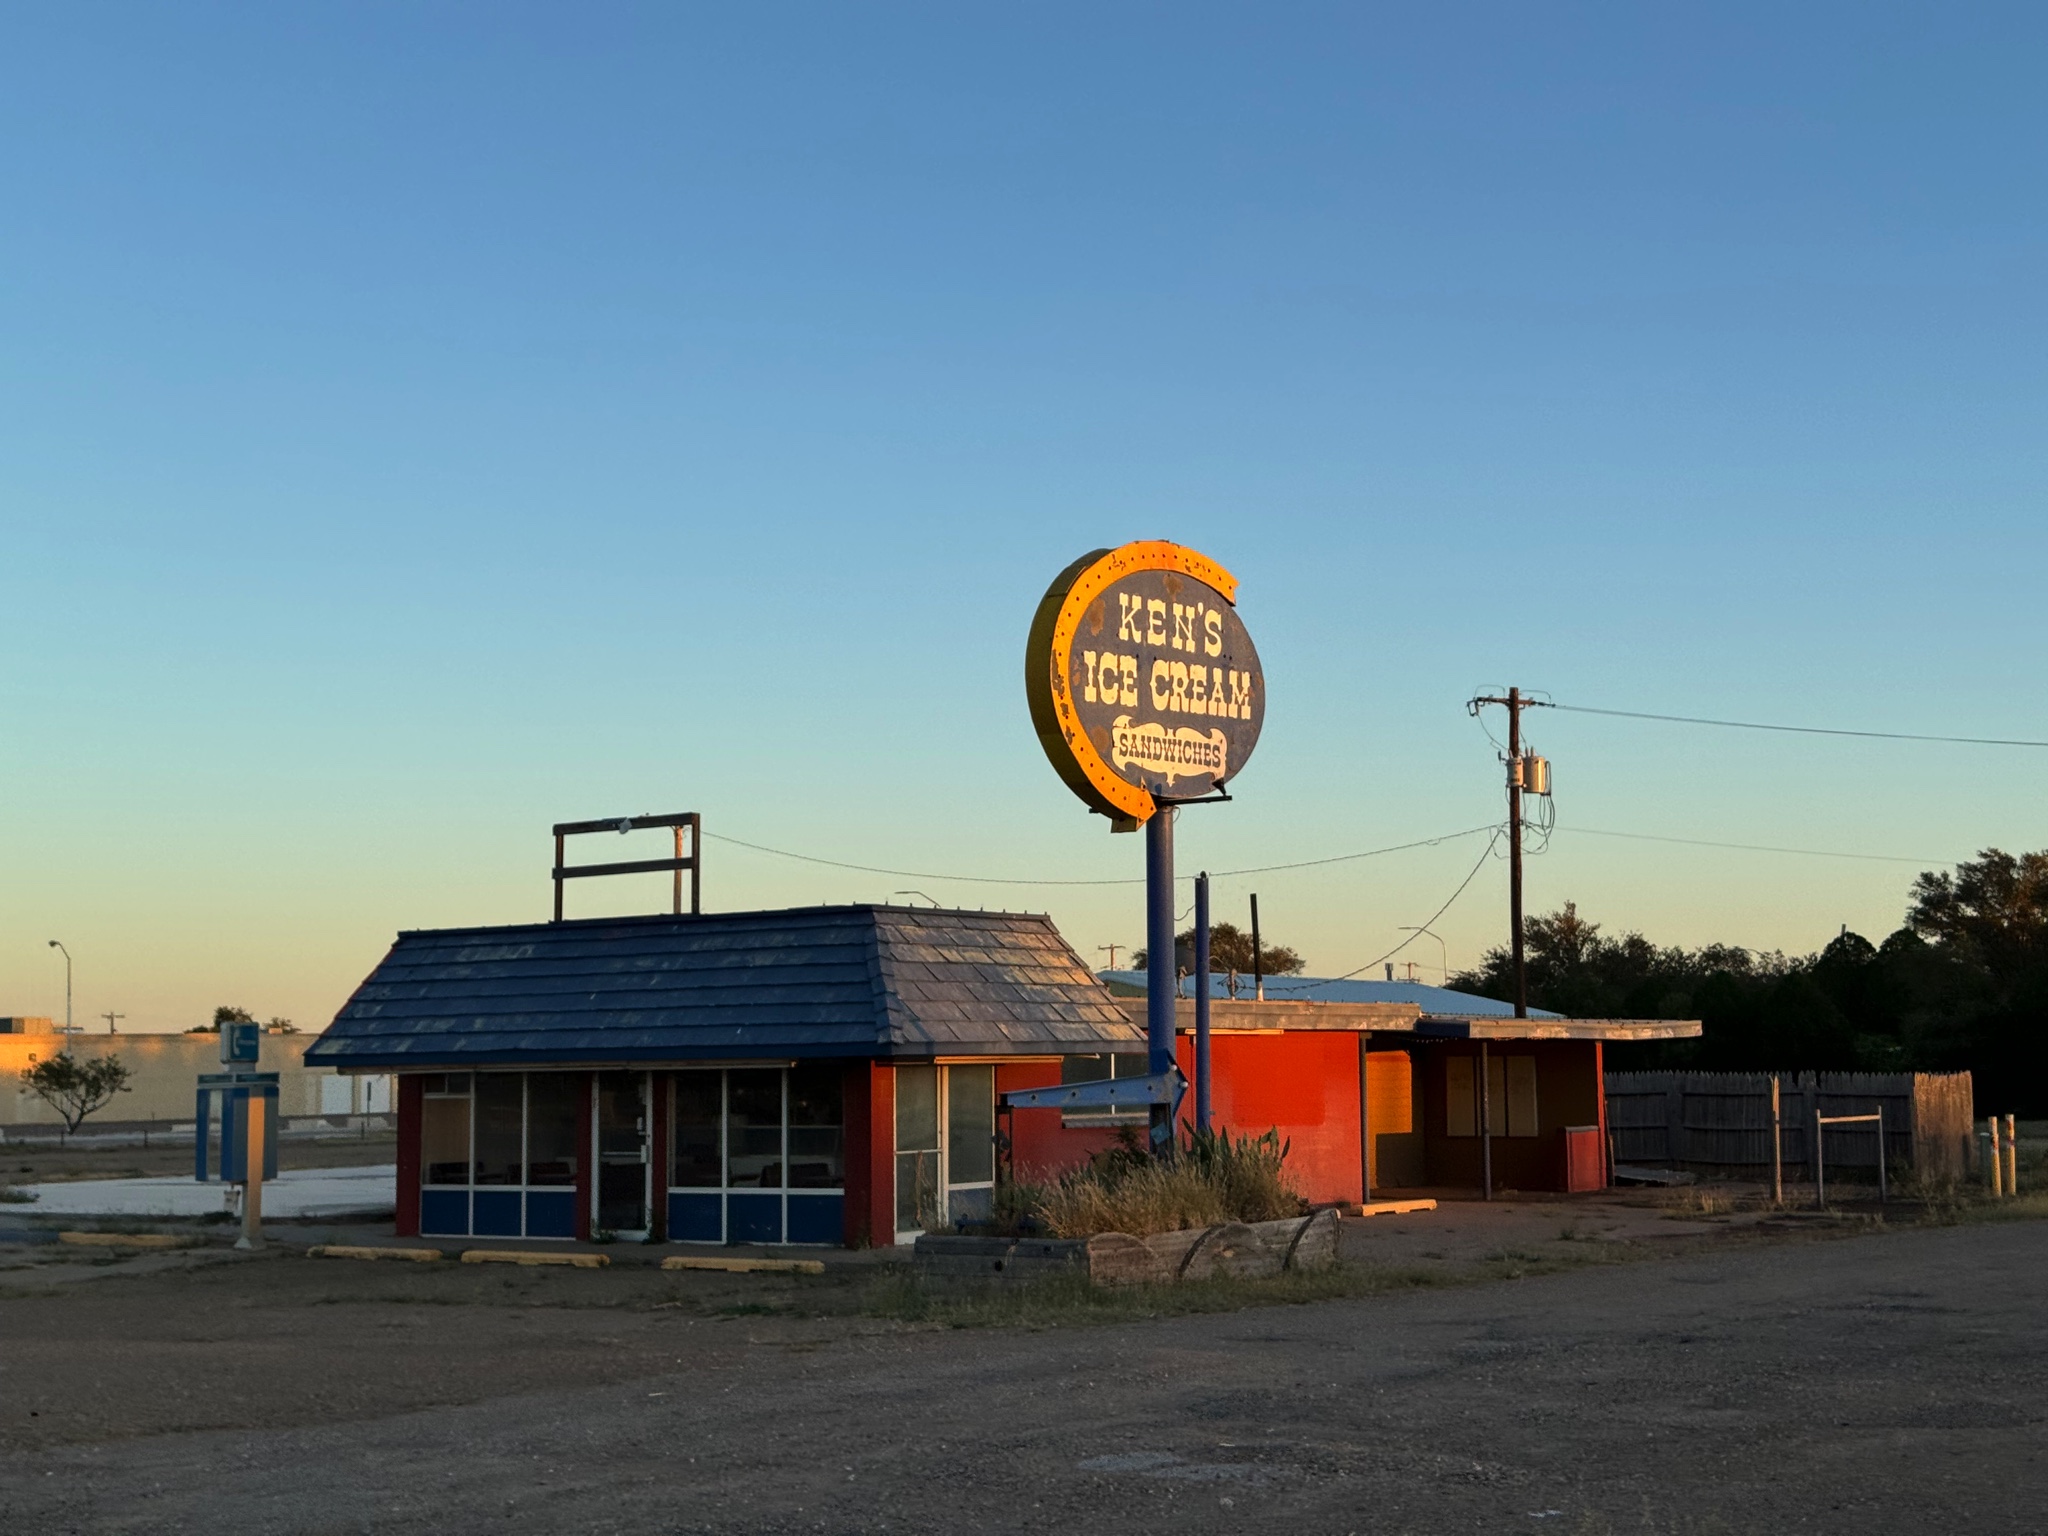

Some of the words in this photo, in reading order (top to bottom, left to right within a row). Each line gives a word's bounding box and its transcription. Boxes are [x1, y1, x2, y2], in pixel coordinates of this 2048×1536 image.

[1119, 593, 1222, 657] KEN'S
[1084, 651, 1138, 707] ICE
[1151, 660, 1251, 720] CREAM
[1119, 733, 1221, 768] SANDWICHES
